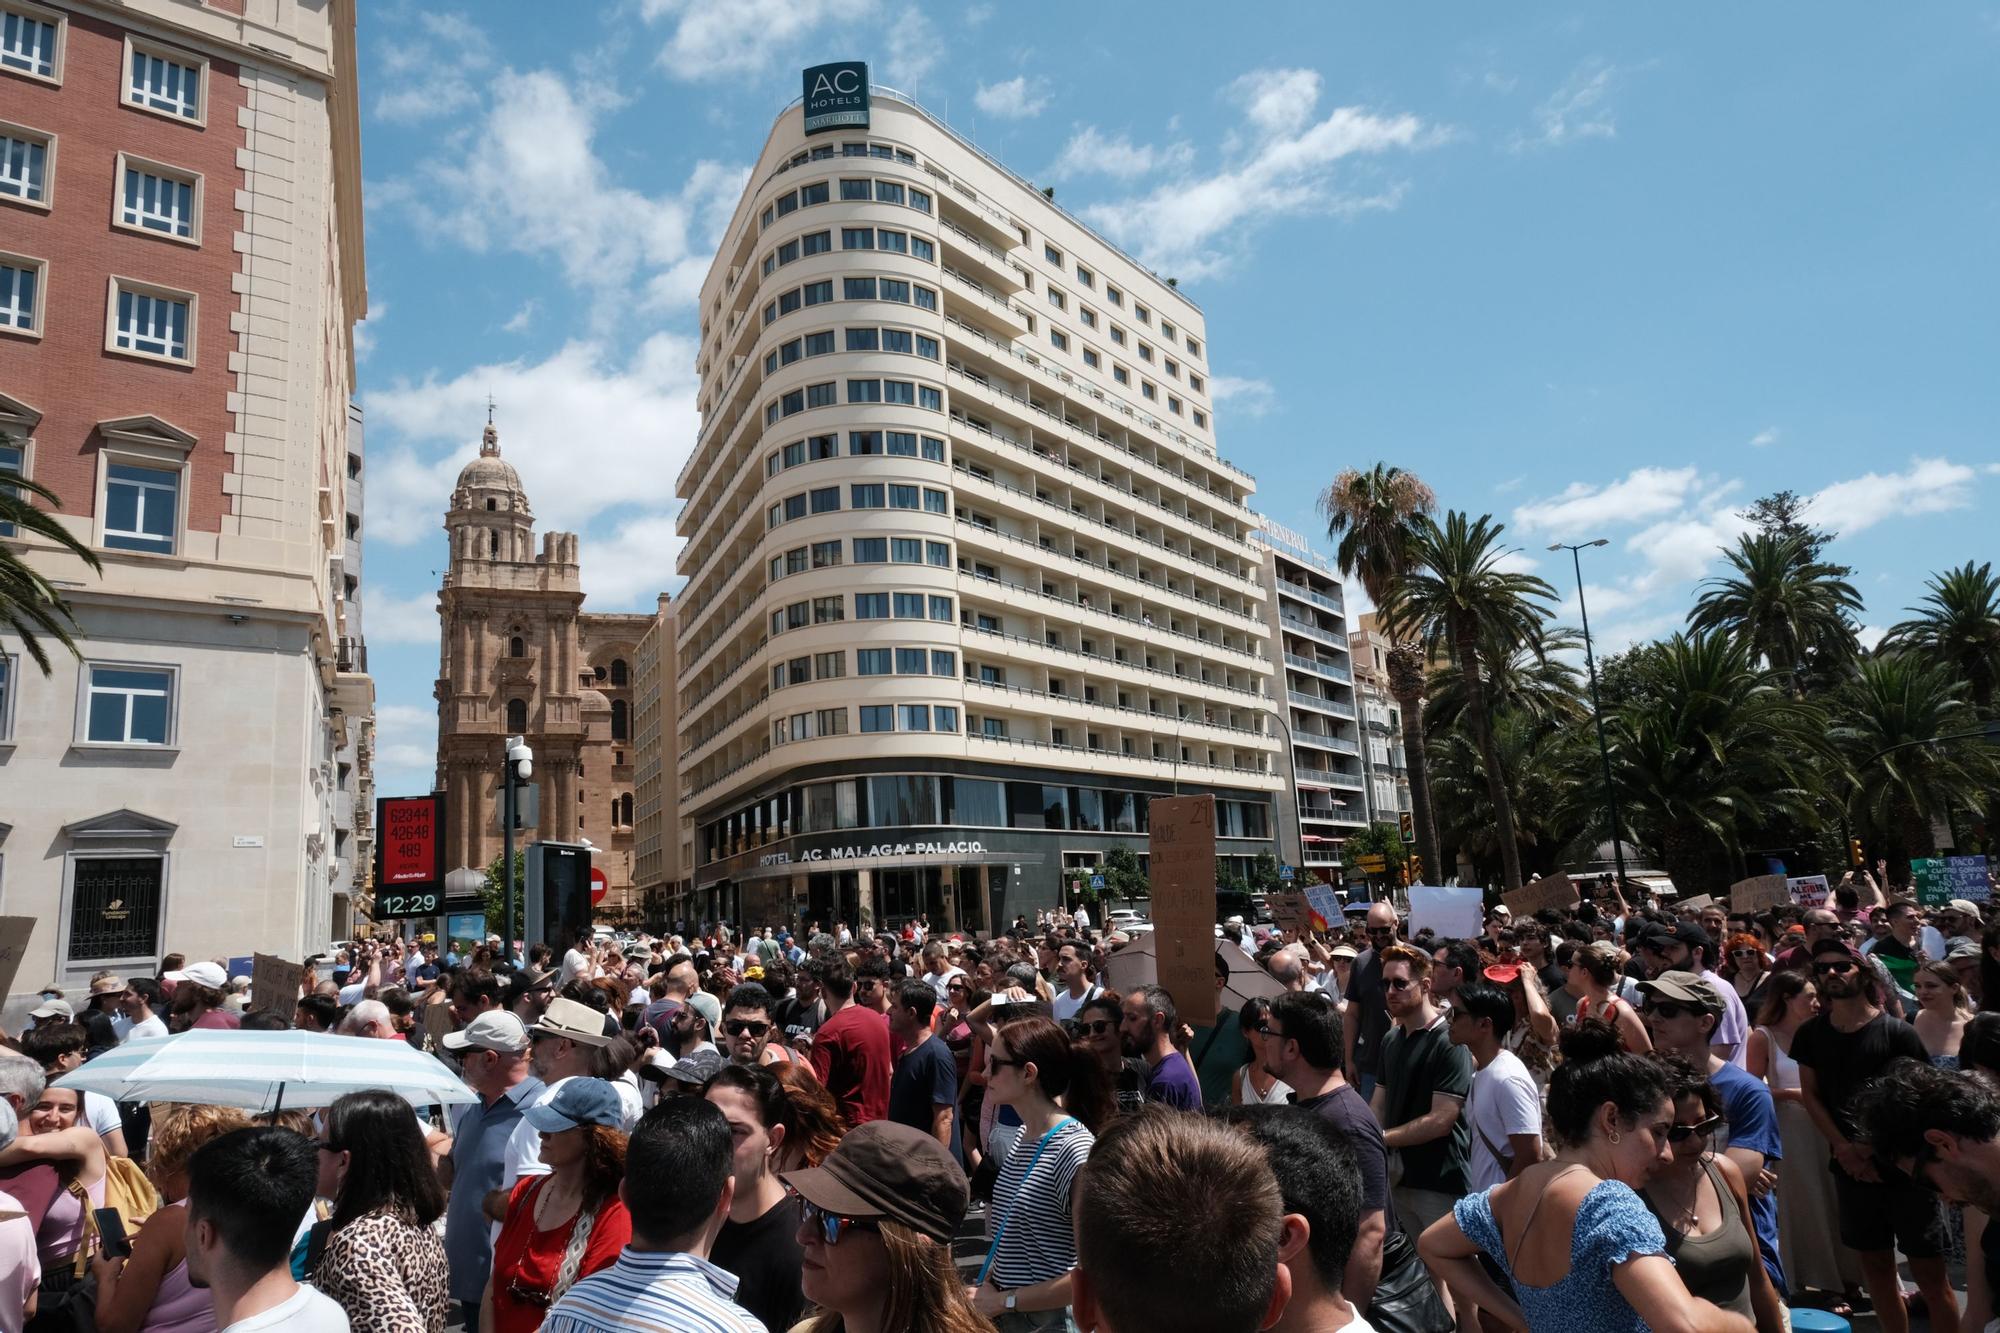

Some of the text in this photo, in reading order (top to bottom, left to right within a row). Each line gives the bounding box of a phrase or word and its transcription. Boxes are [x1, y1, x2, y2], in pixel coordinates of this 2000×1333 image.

[811, 69, 860, 98] AC
[811, 96, 861, 109] HOTELS
[760, 852, 793, 868] HOTEL
[801, 848, 823, 862] AC
[915, 841, 982, 855] PALACIO
[1926, 858, 1975, 867] OYE PACO
[383, 894, 436, 914] 12:29
[1926, 893, 1940, 902] EN
